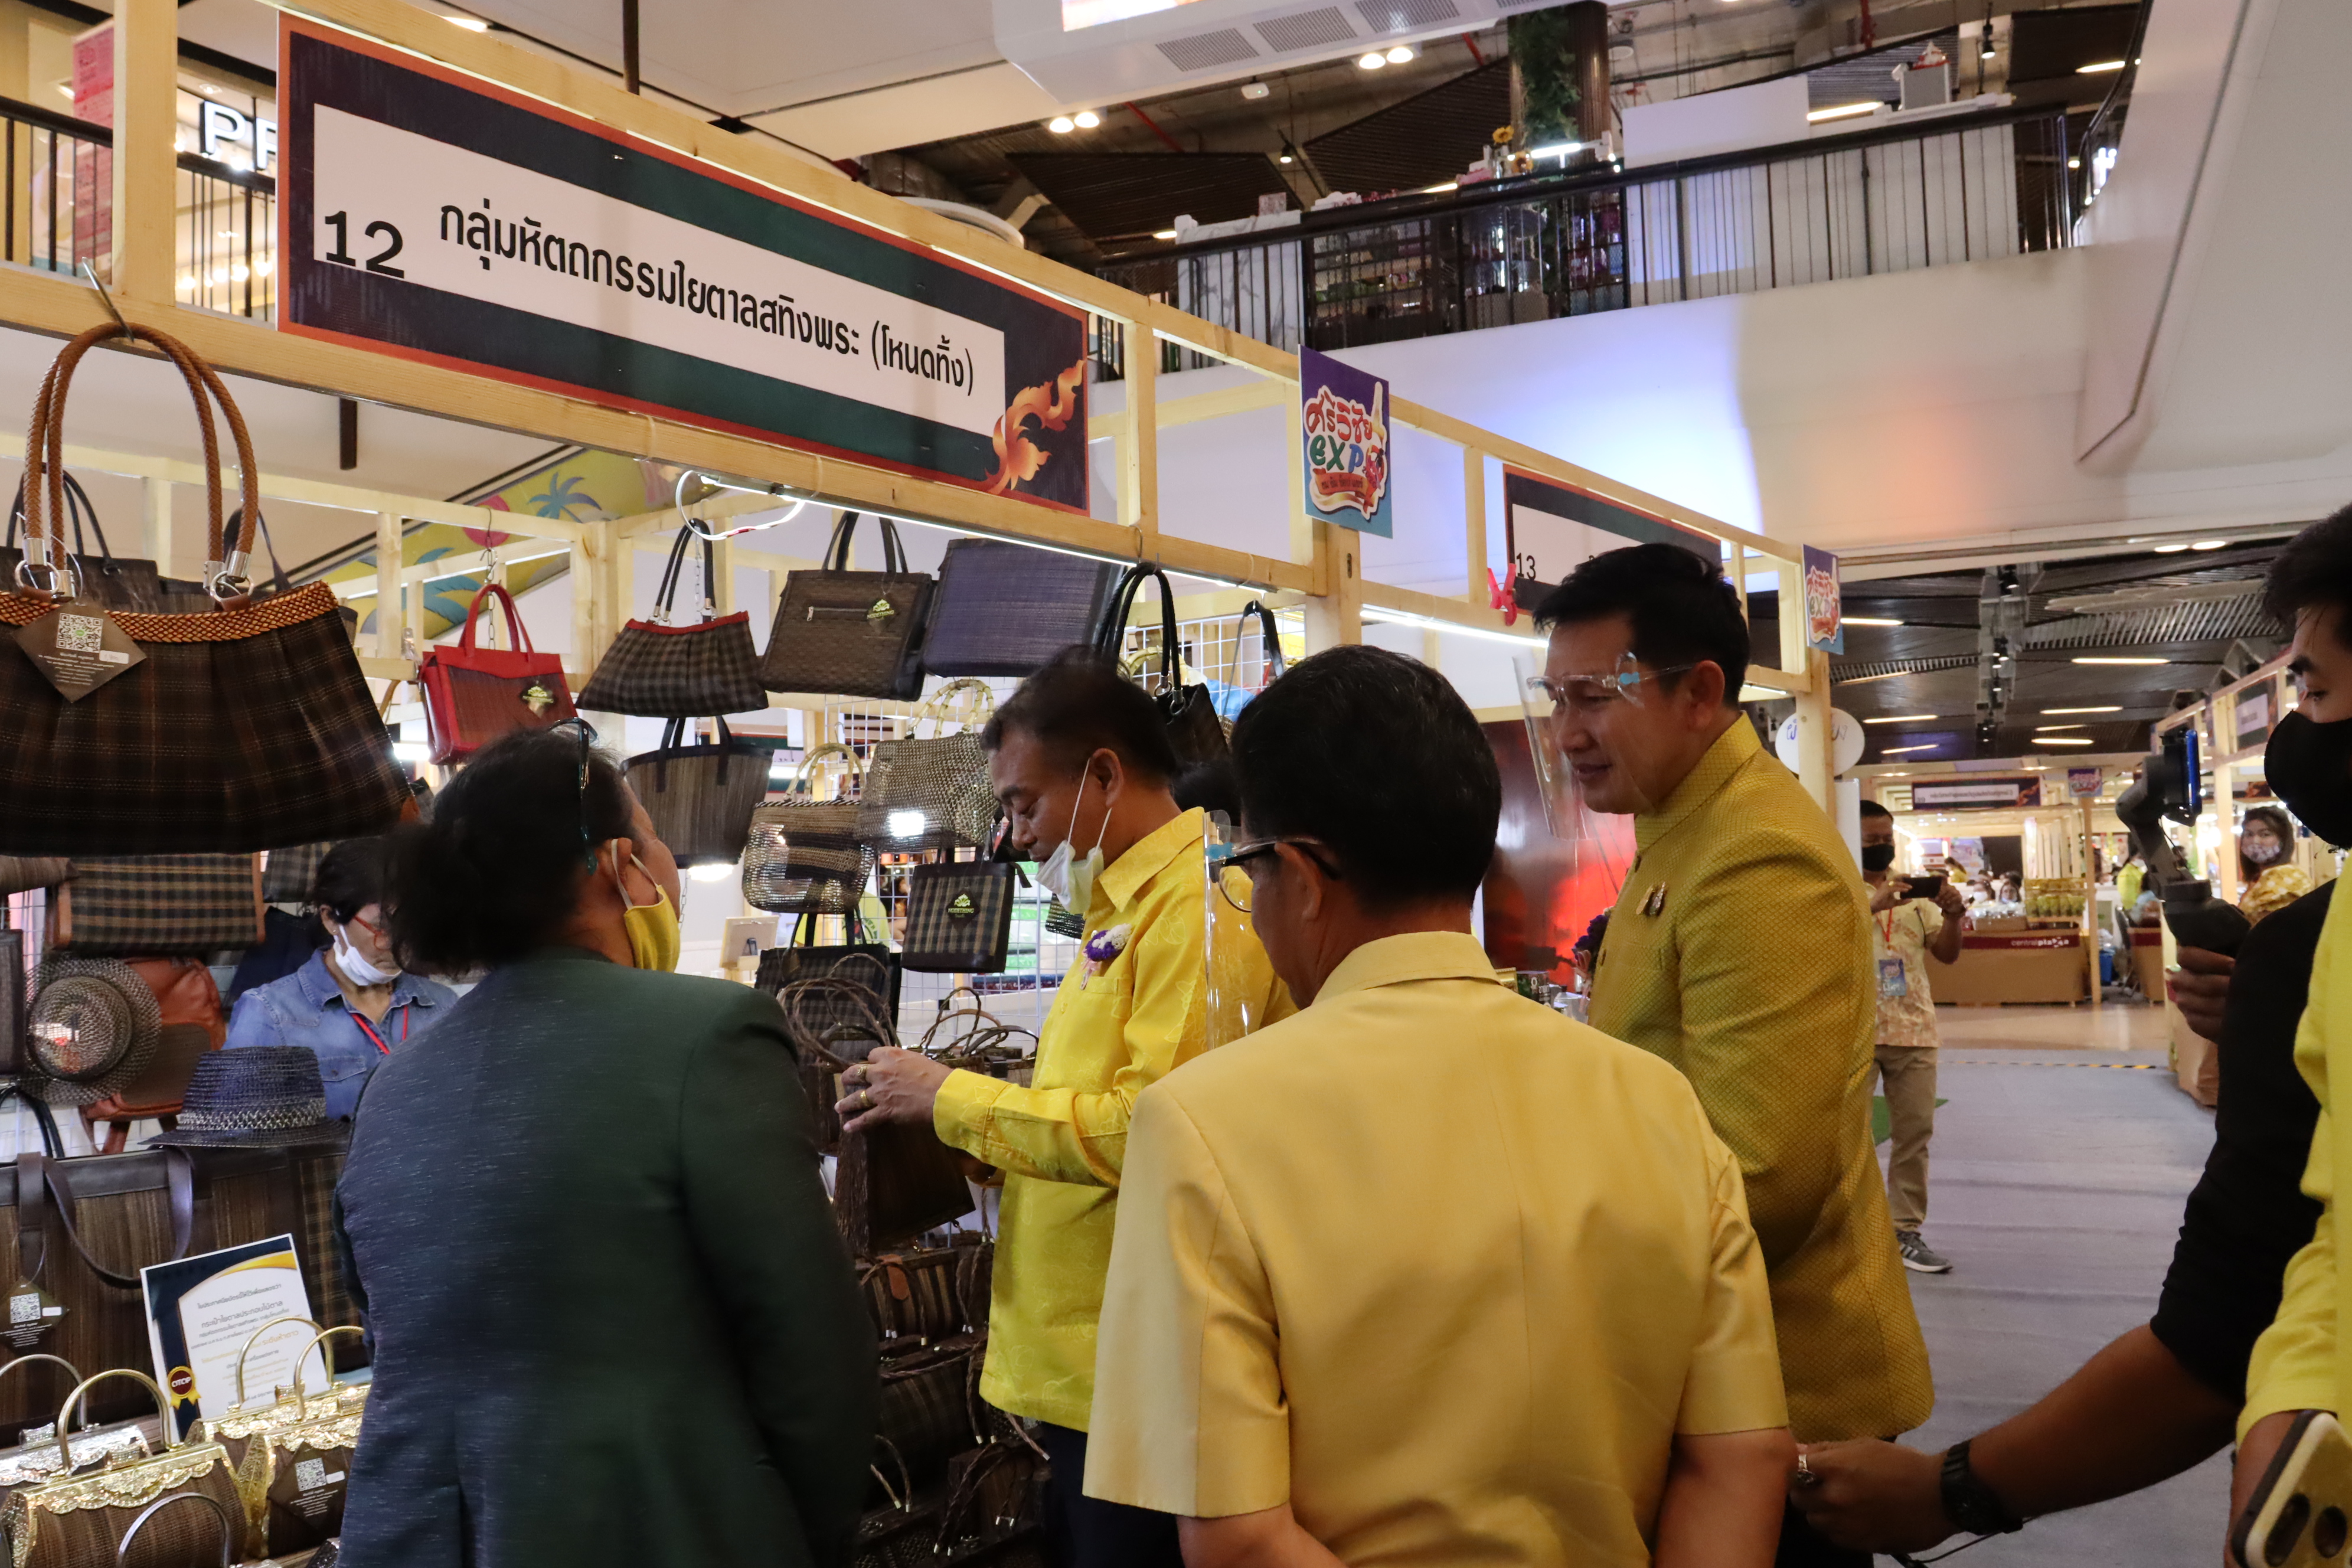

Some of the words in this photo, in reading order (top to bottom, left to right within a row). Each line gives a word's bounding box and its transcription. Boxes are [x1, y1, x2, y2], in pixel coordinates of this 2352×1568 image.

[325, 210, 406, 279] 12
[441, 198, 860, 355] กลุ่มหัตถกรรมใยตาลสทิงพระ
[871, 319, 974, 396] (โหนดทิ้ง)
[1516, 553, 1537, 580] 13
[171, 1376, 192, 1388] OTOP
